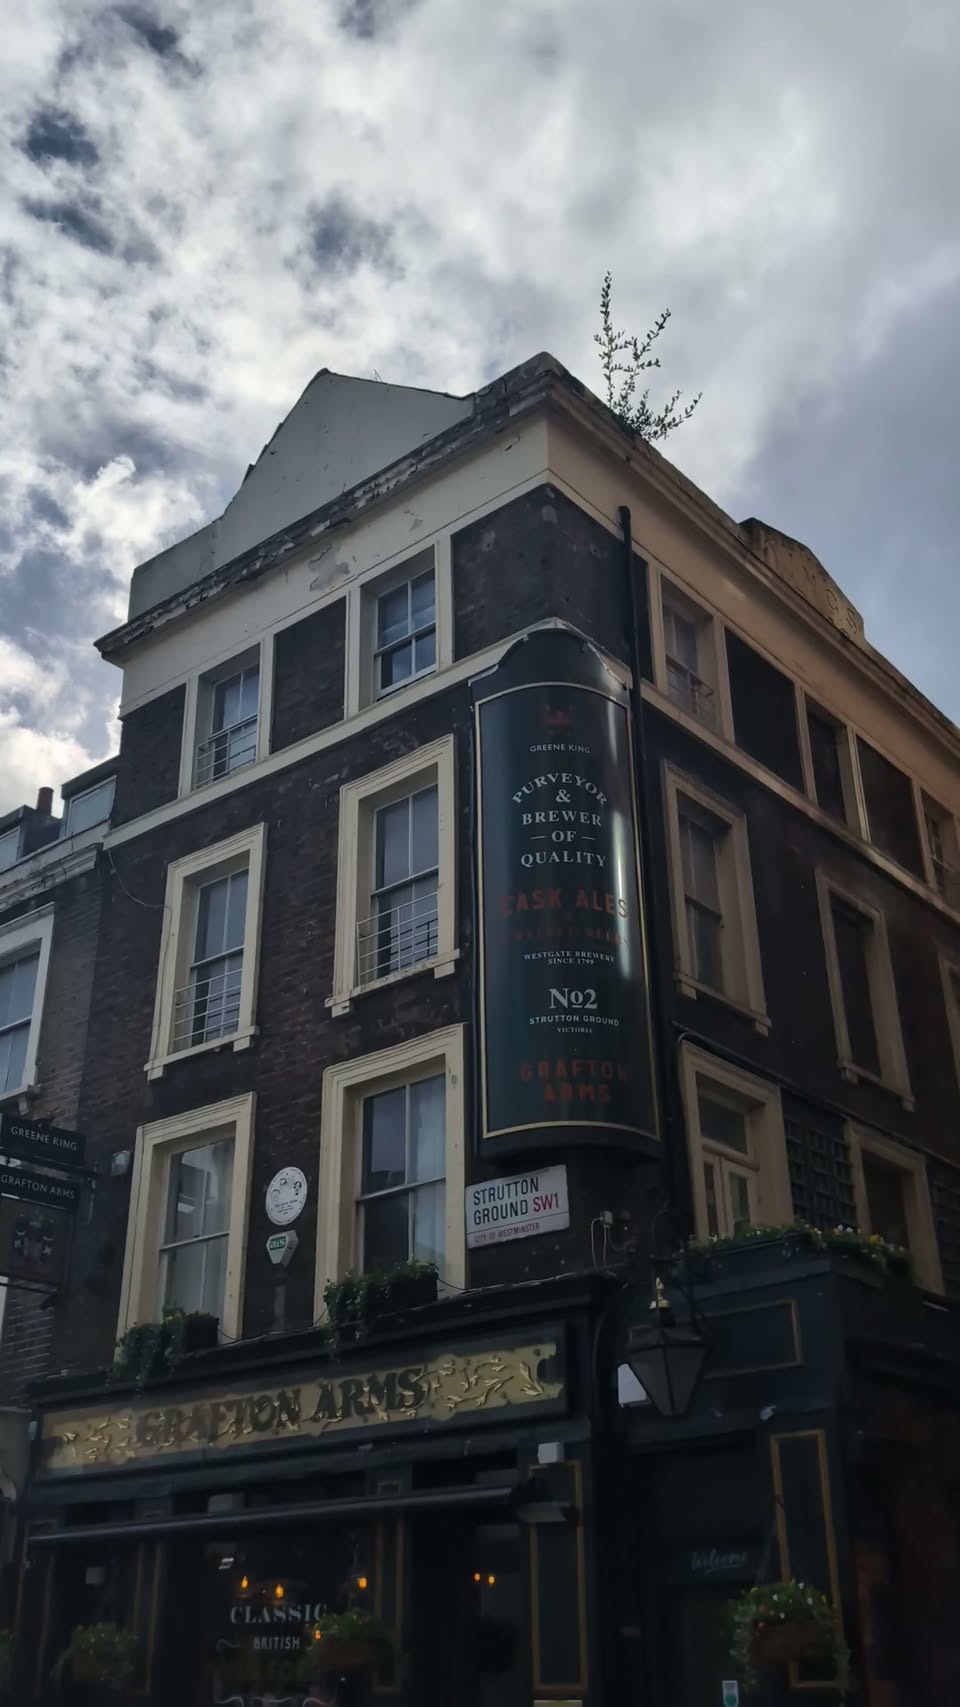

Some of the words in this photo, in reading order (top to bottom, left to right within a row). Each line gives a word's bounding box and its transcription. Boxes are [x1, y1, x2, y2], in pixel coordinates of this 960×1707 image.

[529, 743, 566, 752] GREENE
[568, 744, 591, 753] KING
[512, 772, 608, 805] PURVEYOR
[555, 789, 571, 802] &
[521, 810, 602, 826] BREWER
[551, 830, 577, 842] OF
[520, 851, 608, 867] QUALITY
[500, 887, 563, 917] CASK
[576, 887, 628, 918] ALES
[523, 950, 572, 961] WESTGATE
[575, 951, 616, 963] BREWERY
[548, 957, 575, 965] SINCE
[529, 1014, 580, 1025] STRUTTON
[583, 1015, 620, 1026] GROUND
[10, 1125, 50, 1144] GREENE
[52, 1136, 78, 1151] KING
[0, 1174, 48, 1193] GRAFTON
[49, 1185, 76, 1200] ARMS
[472, 1176, 540, 1206] STRUTTON
[473, 1199, 529, 1226] GROUND
[532, 1192, 560, 1213] SW1
[134, 1388, 300, 1448] GRAFTON
[310, 1366, 424, 1424] ARMS
[253, 1637, 300, 1649] BRITISH
